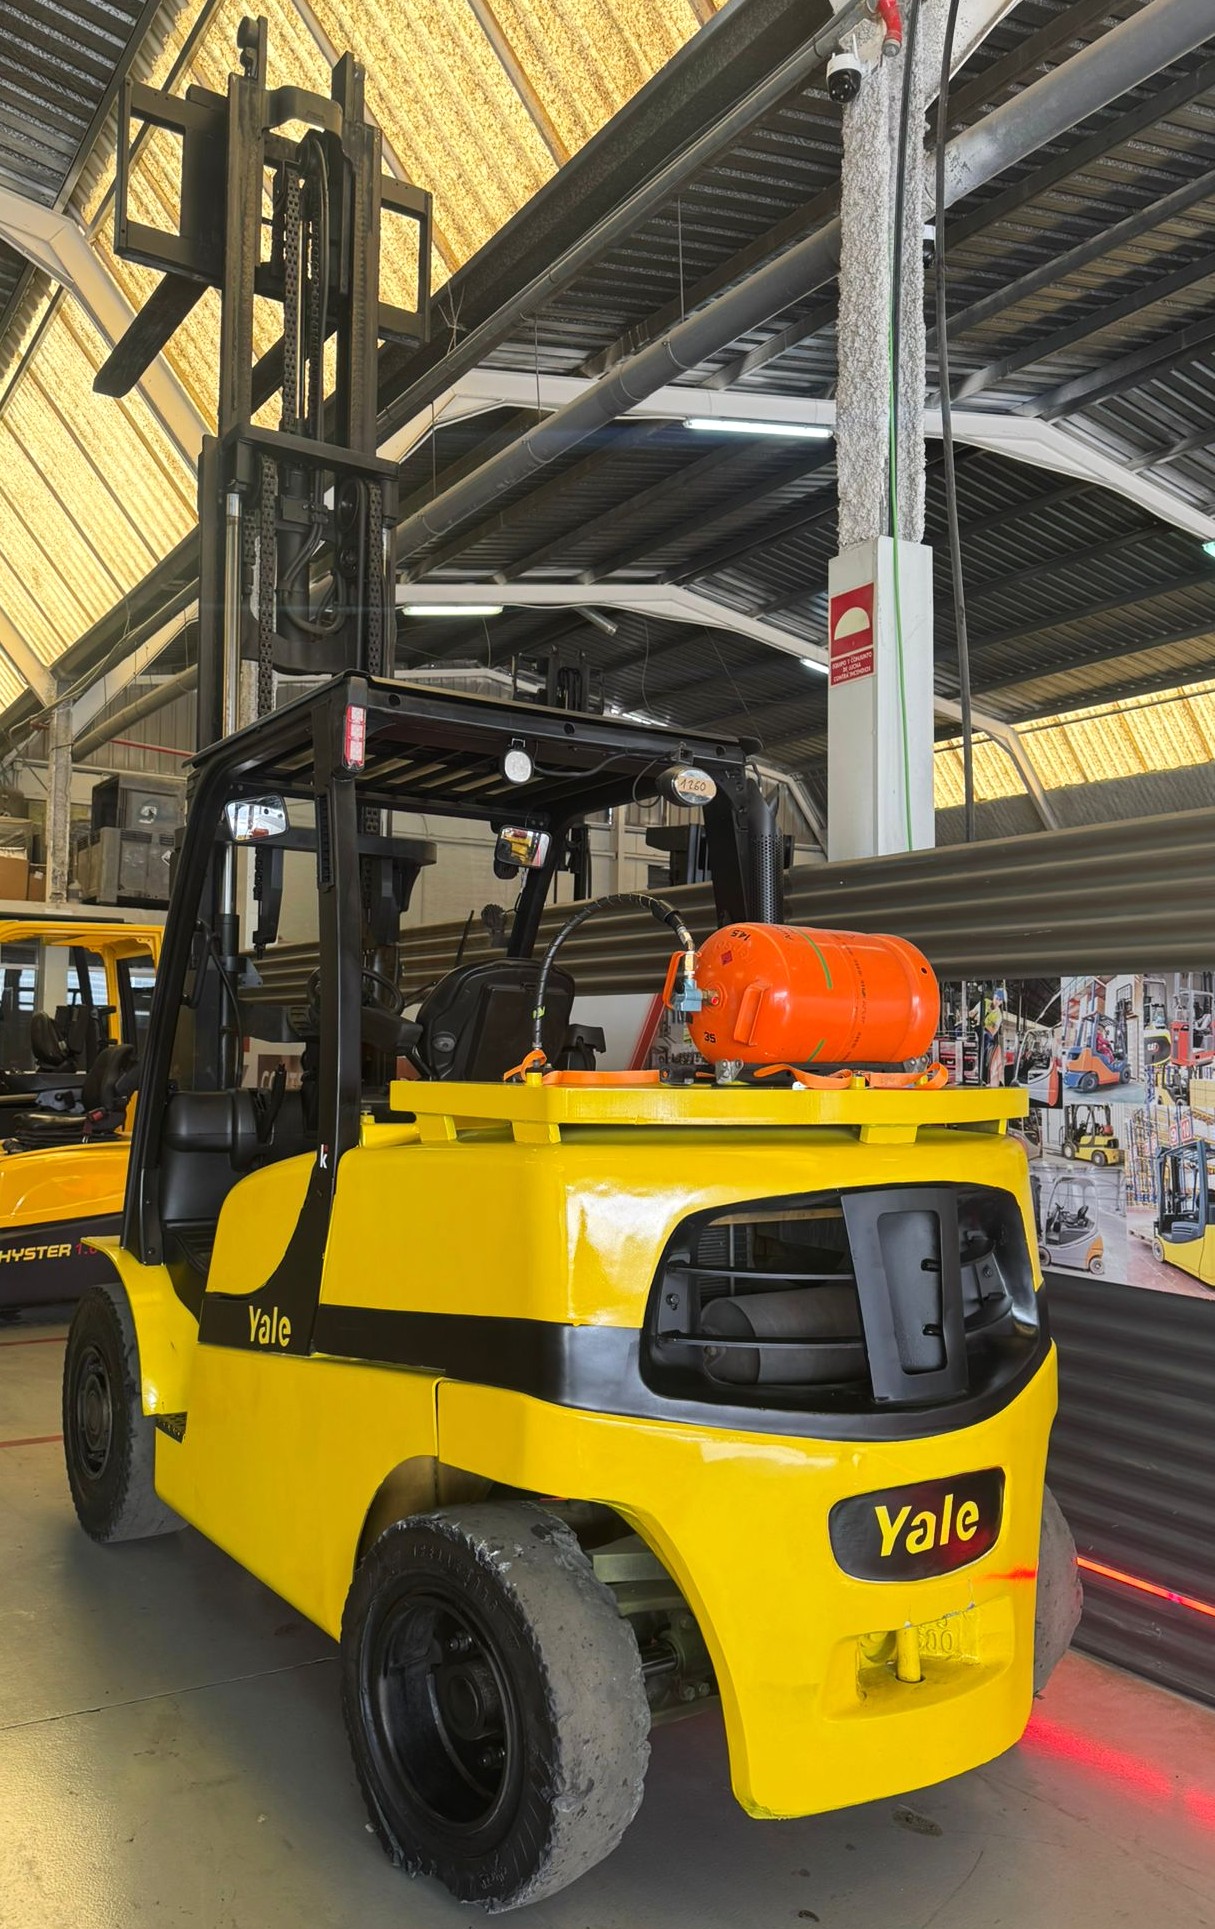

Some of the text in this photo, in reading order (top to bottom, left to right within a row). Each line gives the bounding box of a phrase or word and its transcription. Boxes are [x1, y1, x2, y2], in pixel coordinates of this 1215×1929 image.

[680, 778, 706, 792] 1260
[704, 1031, 716, 1043] 35
[0, 1244, 72, 1263] HYSTER
[249, 1305, 291, 1347] Yale
[875, 1494, 980, 1557] Yale
